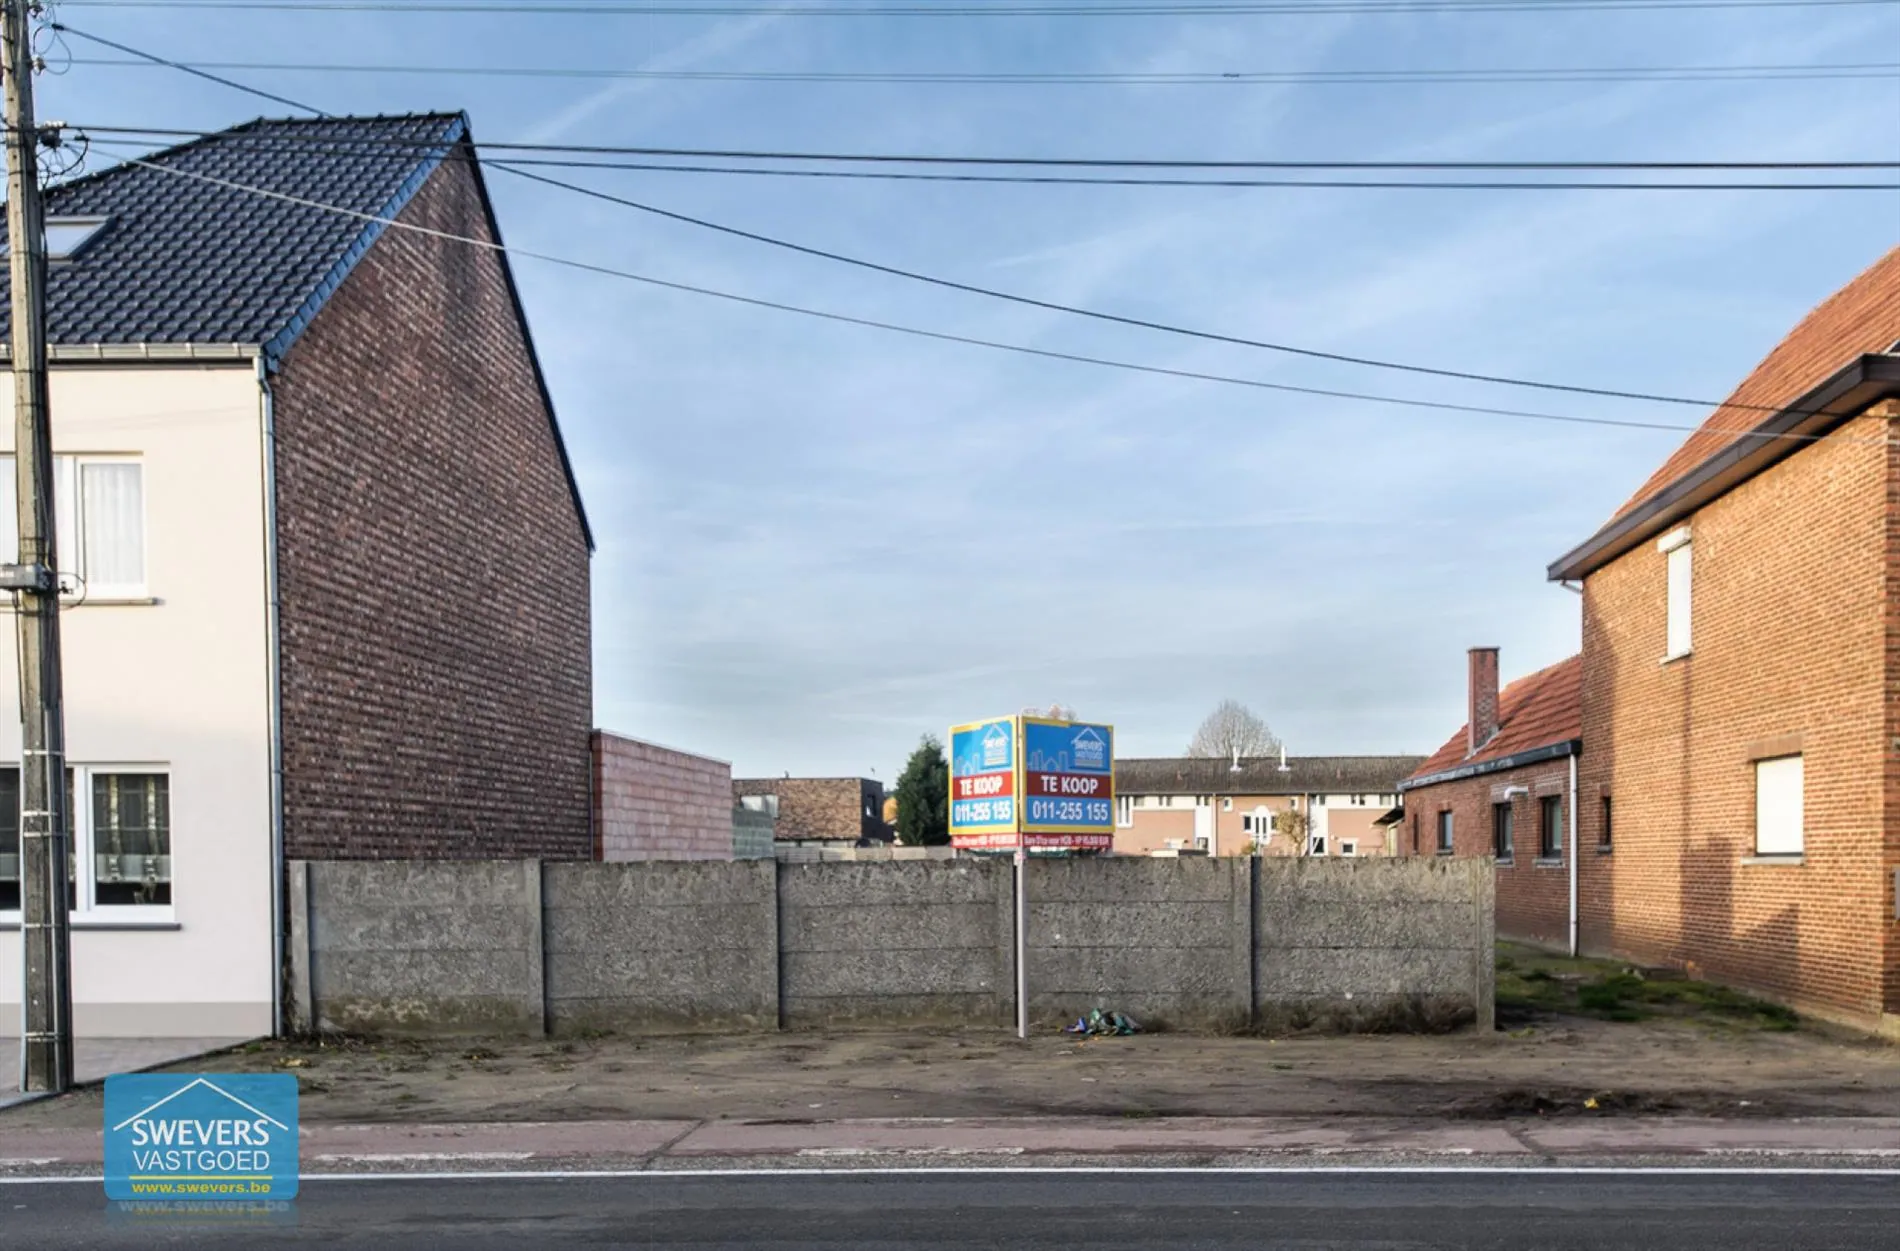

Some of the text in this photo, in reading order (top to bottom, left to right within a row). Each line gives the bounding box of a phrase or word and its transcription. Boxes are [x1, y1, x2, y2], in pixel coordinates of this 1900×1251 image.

[959, 775, 1004, 796] TE KOOP
[1040, 775, 1099, 795] TE KOOP
[955, 800, 1012, 822] 011-255 155
[1032, 800, 1108, 821] 011-255 155
